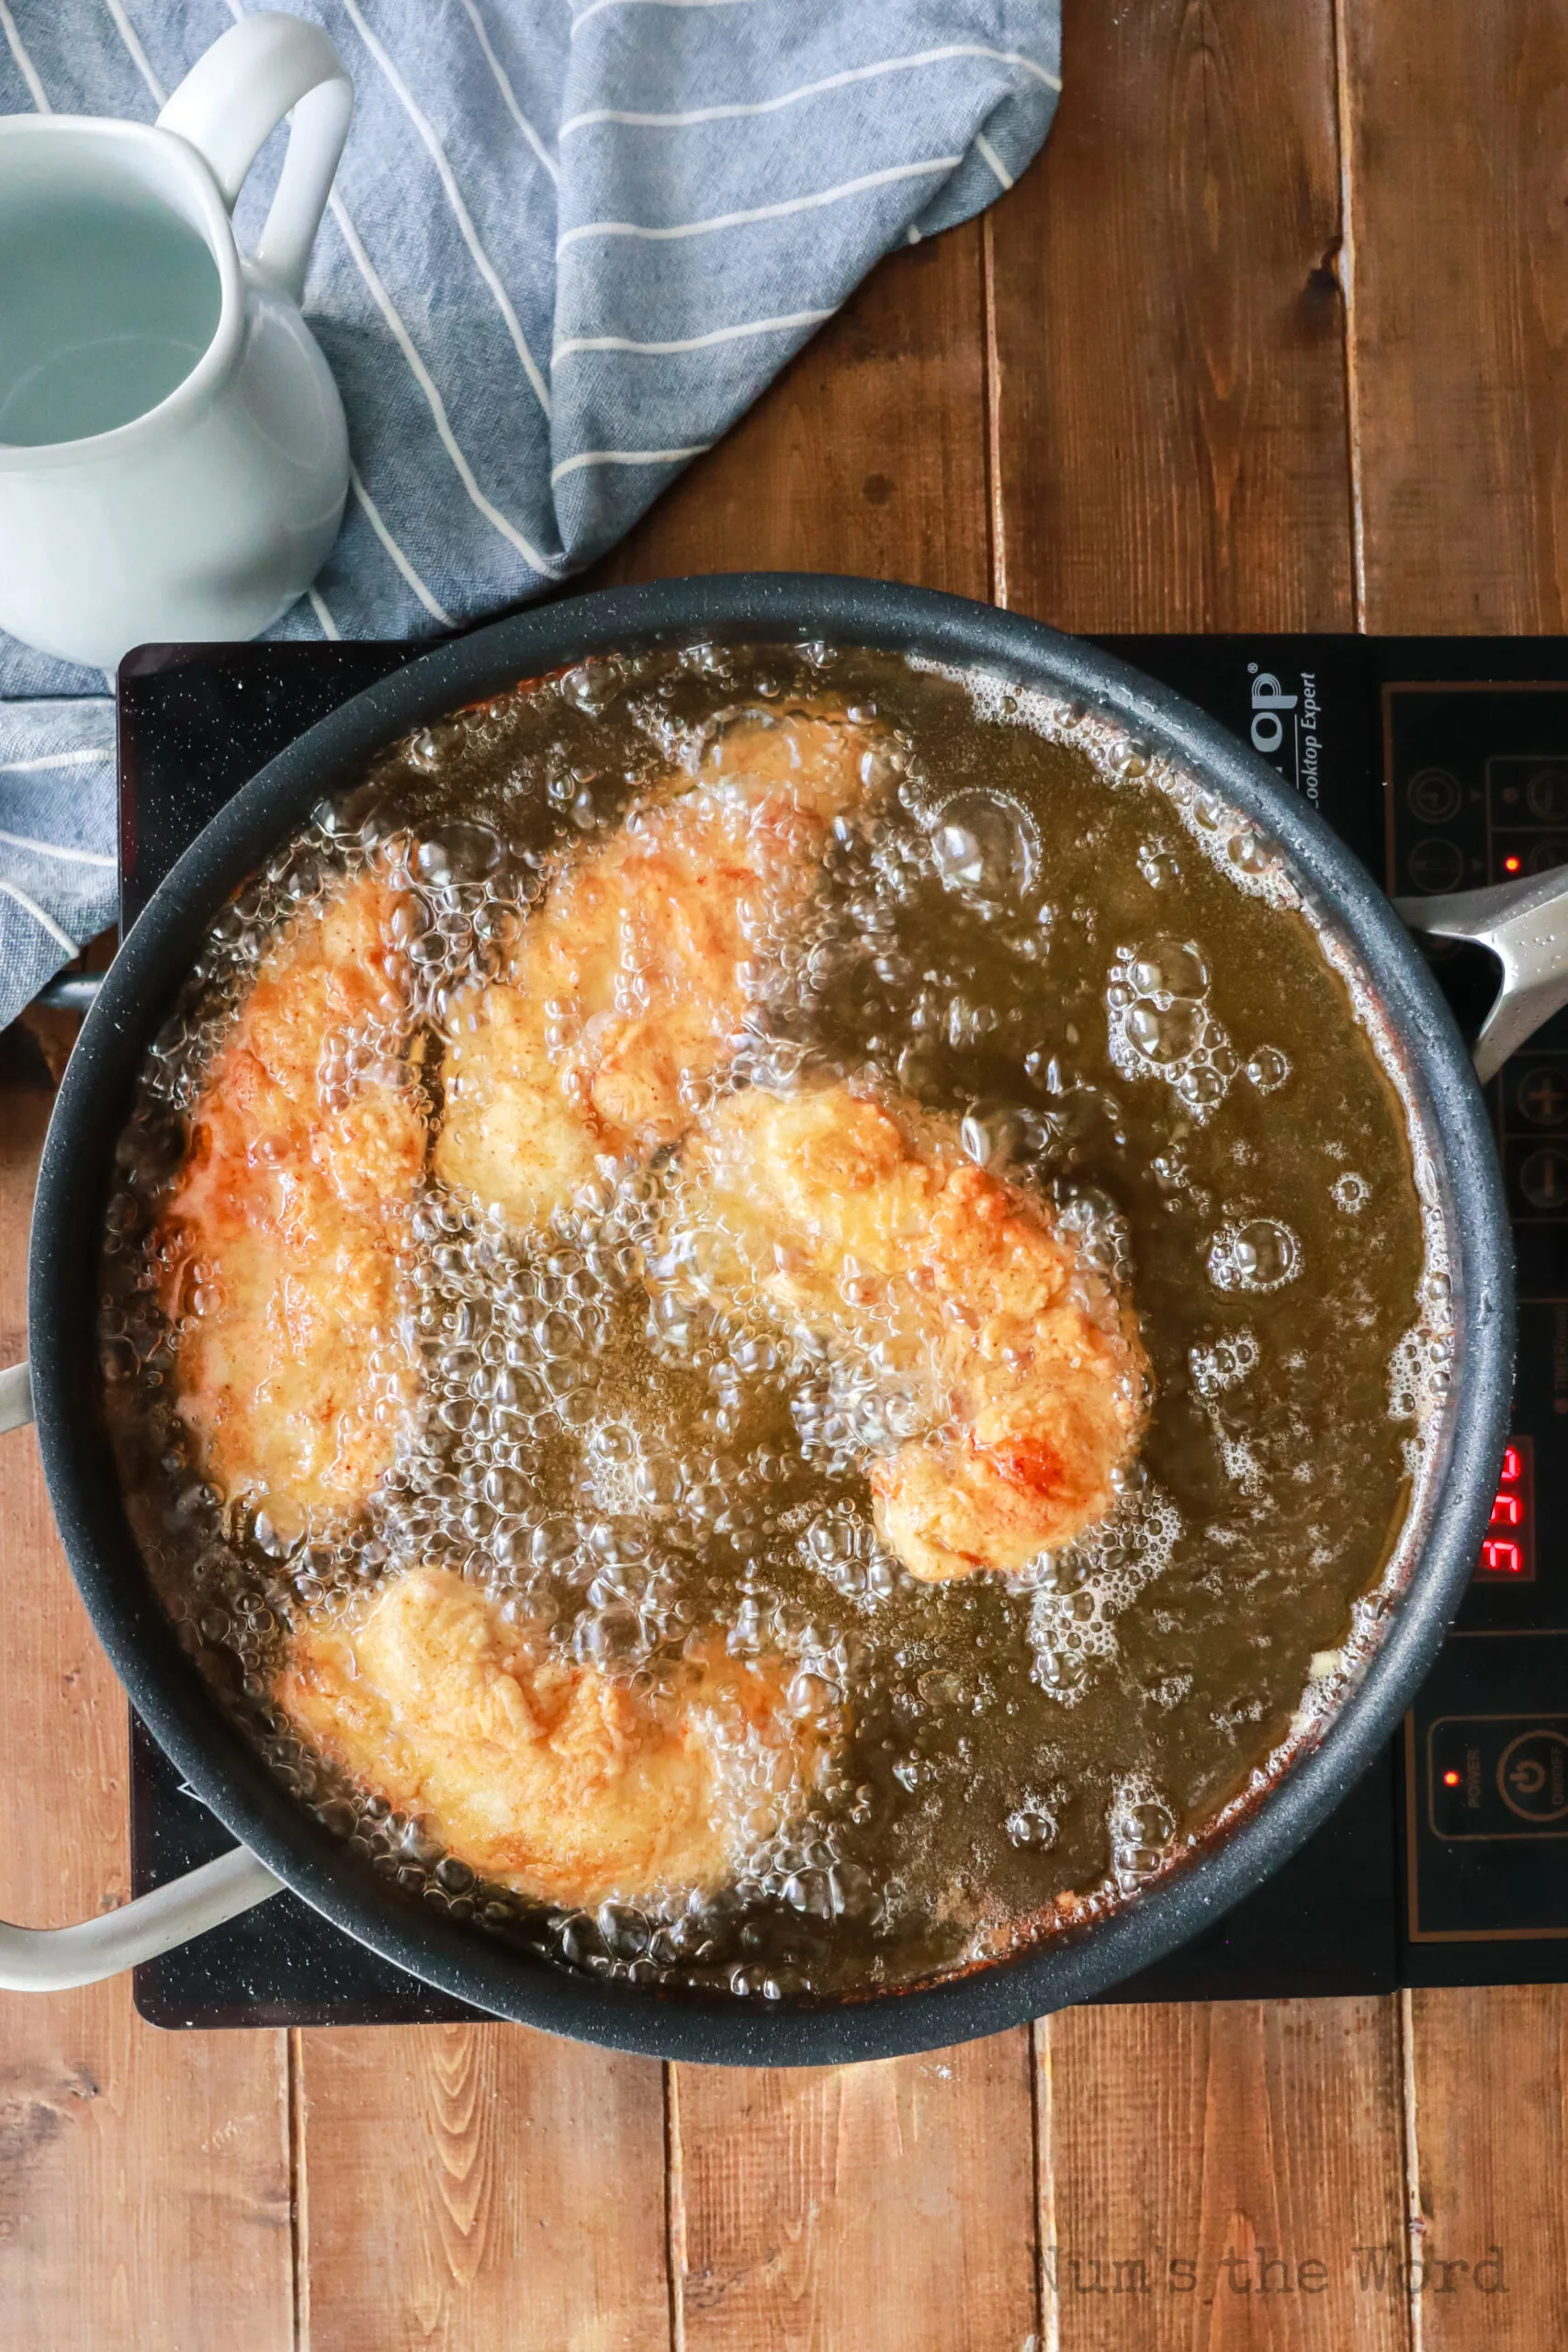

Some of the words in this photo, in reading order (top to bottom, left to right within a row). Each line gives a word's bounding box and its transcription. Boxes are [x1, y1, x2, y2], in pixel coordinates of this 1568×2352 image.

[1250, 673, 1298, 753] op
[1300, 672, 1321, 729] Expert
[1301, 735, 1323, 809] ooktop
[1467, 1747, 1481, 1808] POWER
[1551, 1746, 1564, 1805] ON/OFF
